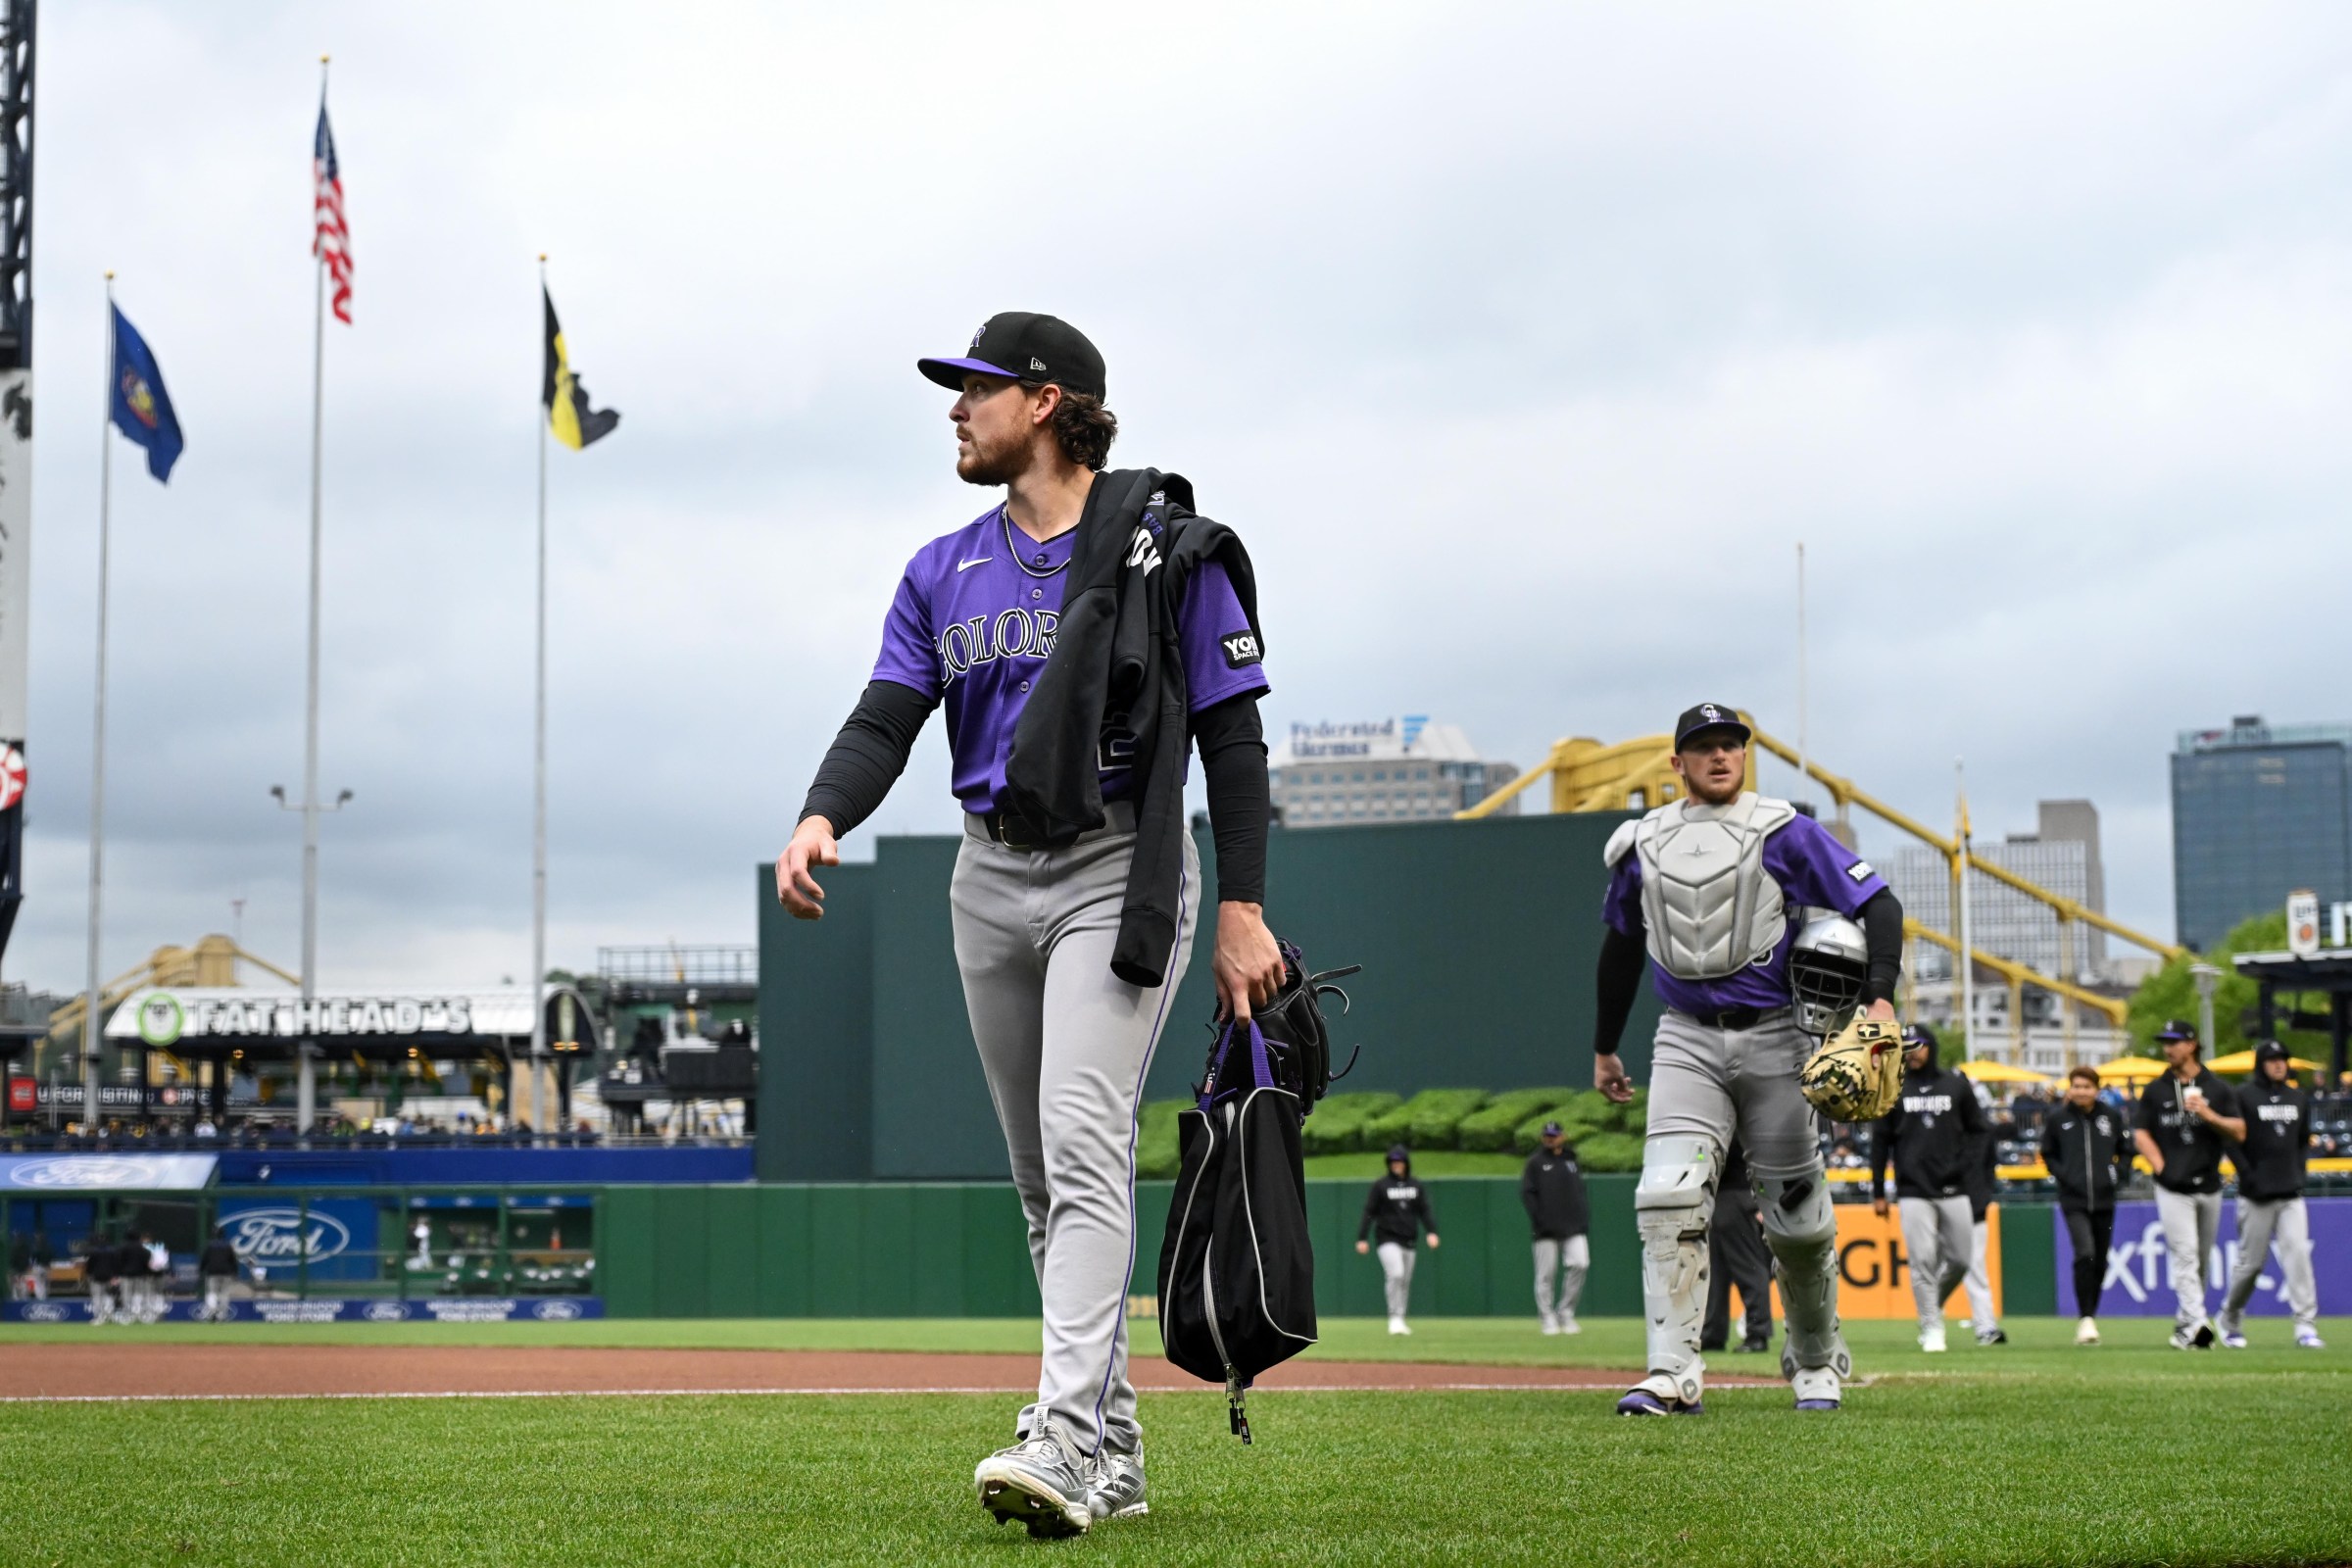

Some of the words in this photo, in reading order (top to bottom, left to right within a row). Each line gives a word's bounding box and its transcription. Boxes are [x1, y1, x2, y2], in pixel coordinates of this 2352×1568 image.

[196, 997, 278, 1036] FAT
[293, 997, 472, 1035] HEAD'S
[230, 1217, 325, 1255] Ford
